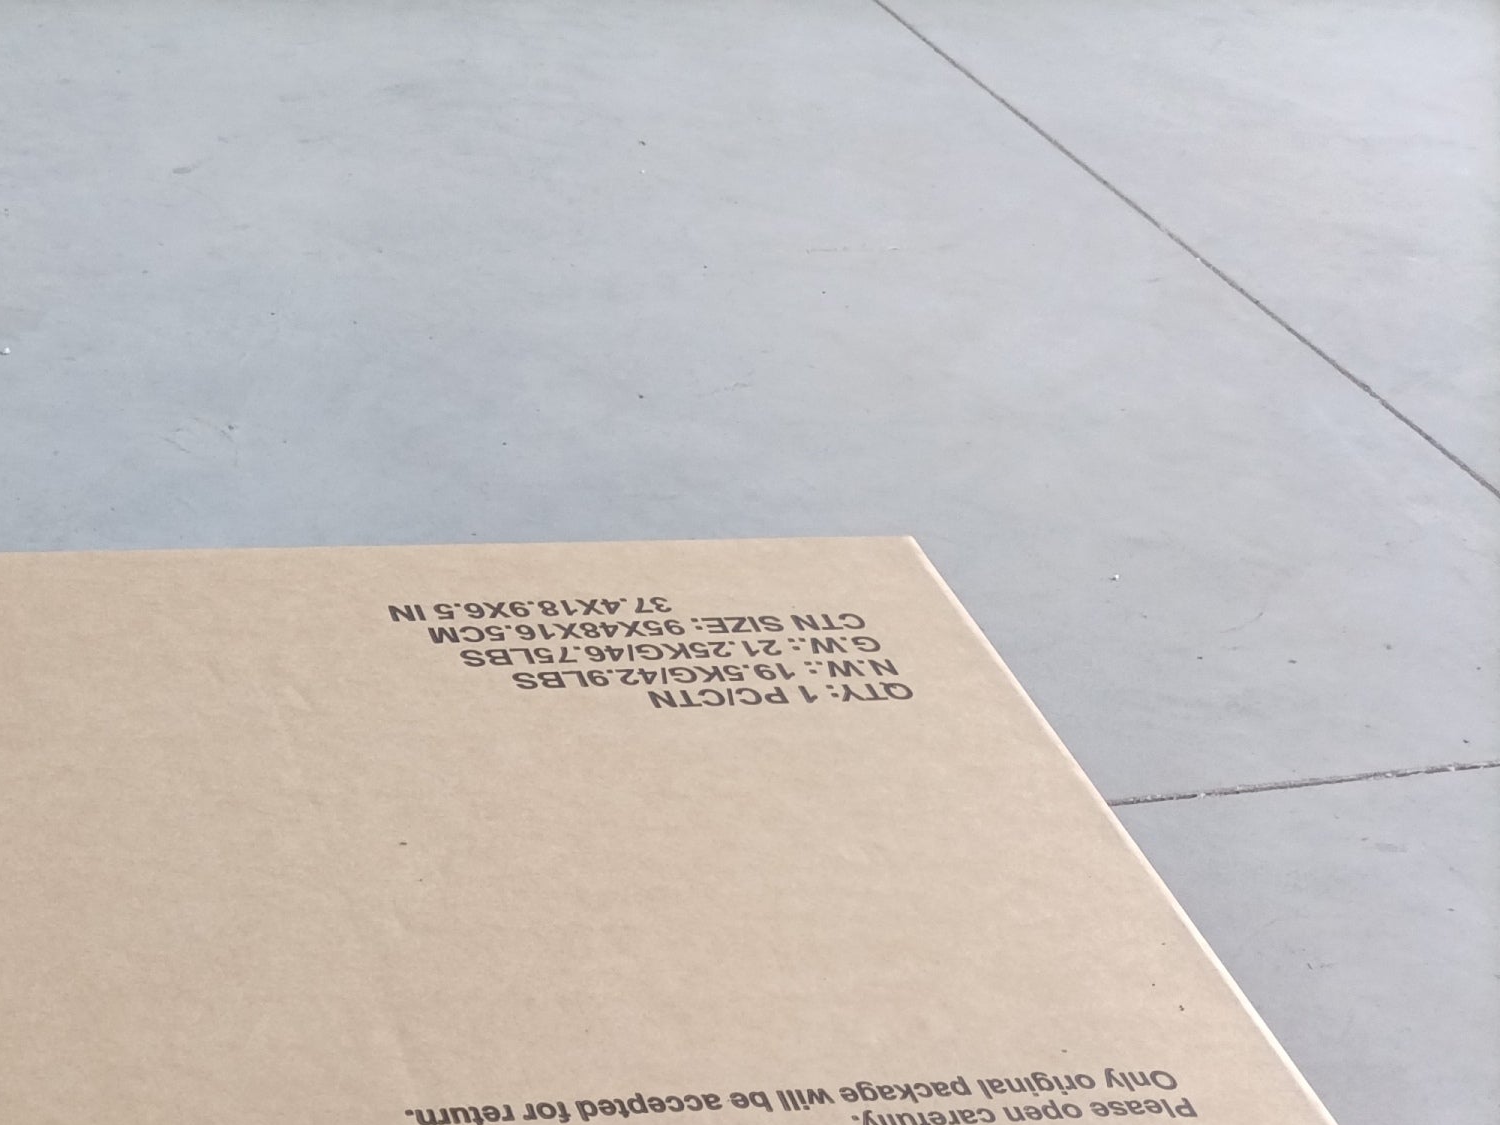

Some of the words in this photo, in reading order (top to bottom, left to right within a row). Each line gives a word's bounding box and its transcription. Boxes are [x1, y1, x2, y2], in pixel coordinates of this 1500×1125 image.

[388, 604, 426, 622] IN
[437, 597, 672, 620] 37.4X18.9X6.5
[428, 619, 685, 644] 95X48X16.5CM
[691, 616, 784, 633] SIZE:
[790, 613, 865, 631] CTN
[460, 640, 782, 667] 21.25KG/46.75LBS
[792, 636, 881, 654] G.W.:
[512, 663, 795, 689] 19.5KG/42.9LBS
[809, 659, 899, 677] N.W.:
[648, 686, 789, 708] PC/CTN
[798, 685, 818, 703] 1
[831, 682, 913, 702] QTY:
[839, 1076, 972, 1104] package
[977, 1072, 1095, 1099] original
[1104, 1068, 1177, 1092] Only
[575, 1092, 723, 1122] accepted
[729, 1091, 773, 1112] be
[776, 1088, 835, 1111] will
[1002, 1099, 1082, 1122] open
[1090, 1098, 1198, 1118] Please
[405, 1104, 515, 1125] return.
[523, 1101, 571, 1123] for
